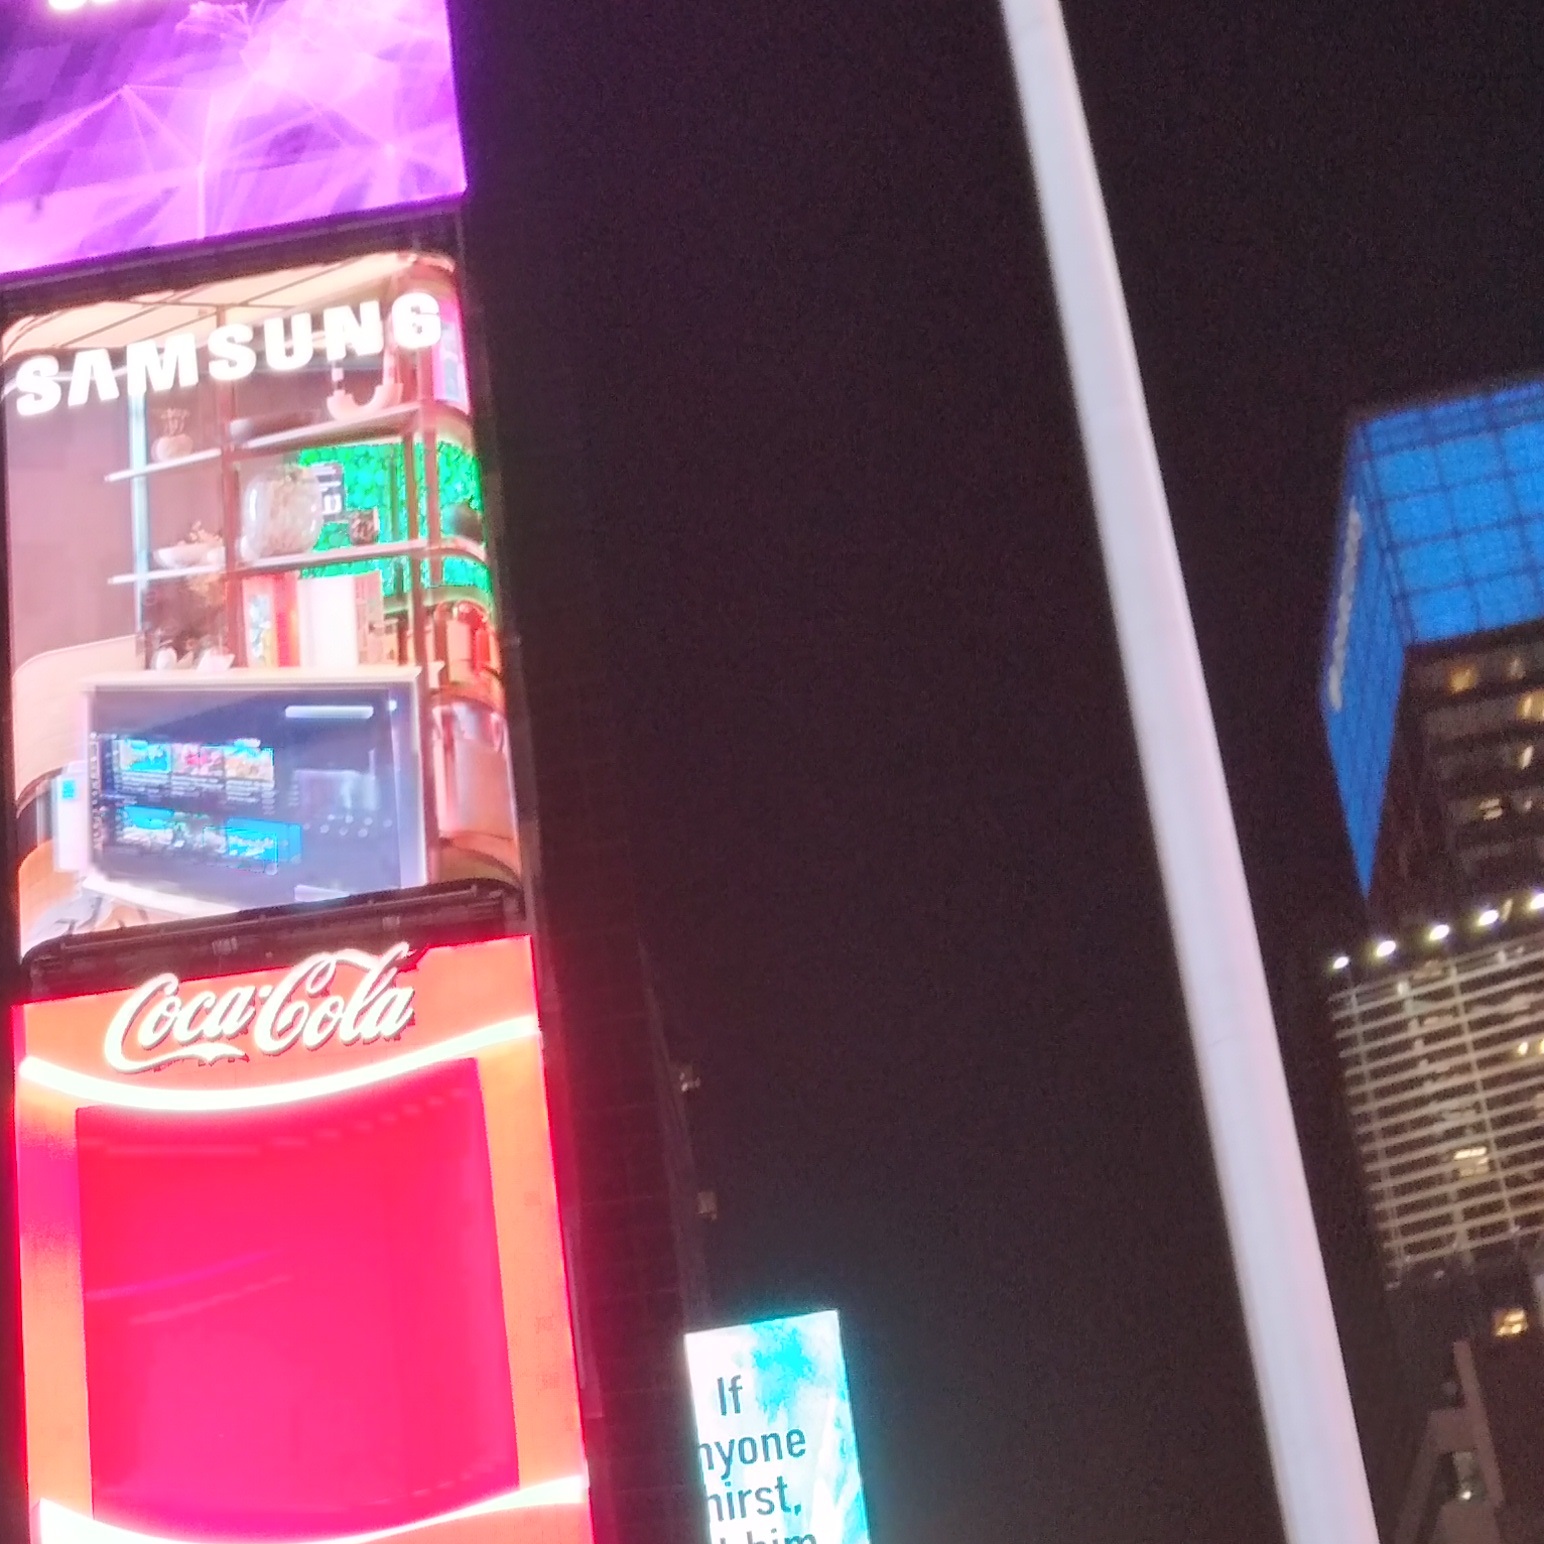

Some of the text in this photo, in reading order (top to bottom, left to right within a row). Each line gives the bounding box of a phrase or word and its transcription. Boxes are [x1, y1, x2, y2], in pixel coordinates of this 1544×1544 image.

[15, 293, 442, 416] SAMSUNG
[104, 941, 416, 1074] Coca-Cola
[716, 1374, 744, 1417] If
